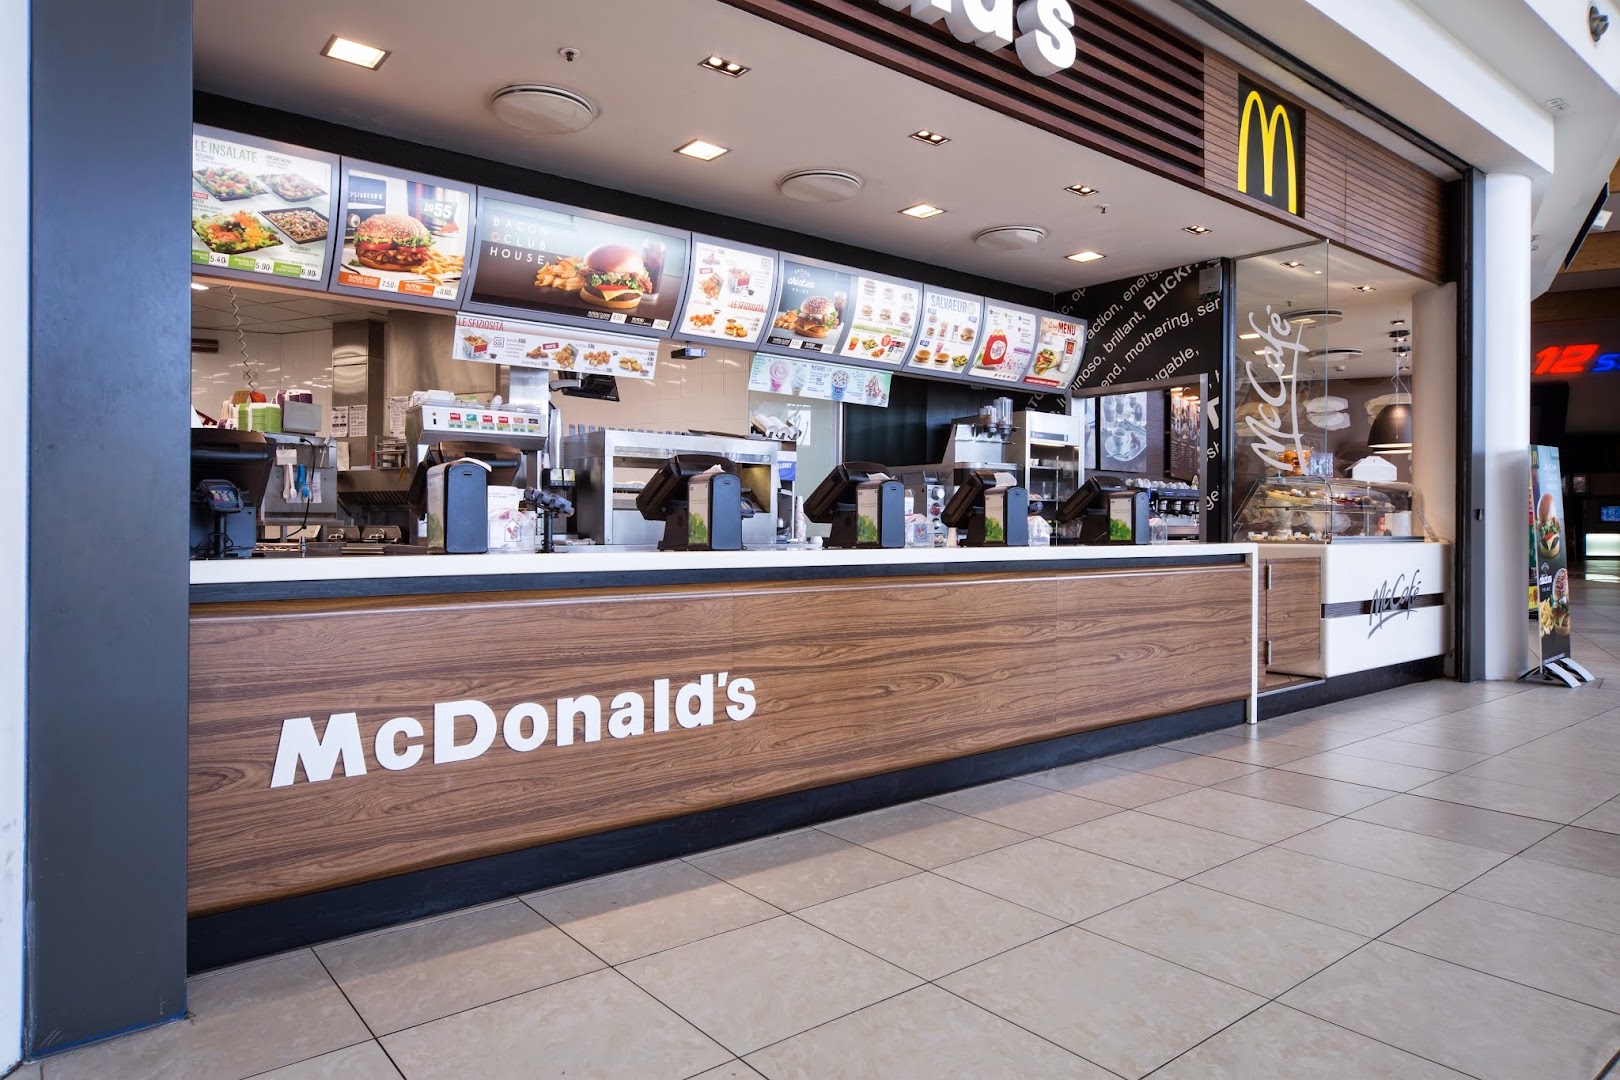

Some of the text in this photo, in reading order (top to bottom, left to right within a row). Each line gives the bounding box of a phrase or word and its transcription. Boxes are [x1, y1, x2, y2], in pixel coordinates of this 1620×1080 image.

[195, 140, 207, 152] LE
[209, 142, 258, 163] INSALATE
[493, 216, 549, 235] BACON
[490, 246, 545, 265] HOUSE
[1058, 322, 1076, 336] MENU
[1102, 310, 1146, 353] brillant,
[1124, 311, 1194, 364] mothering,
[1534, 344, 1600, 375] 12
[1245, 305, 1309, 475] McCafé
[1368, 569, 1421, 639] McCafé
[270, 671, 757, 789] McDonald's
